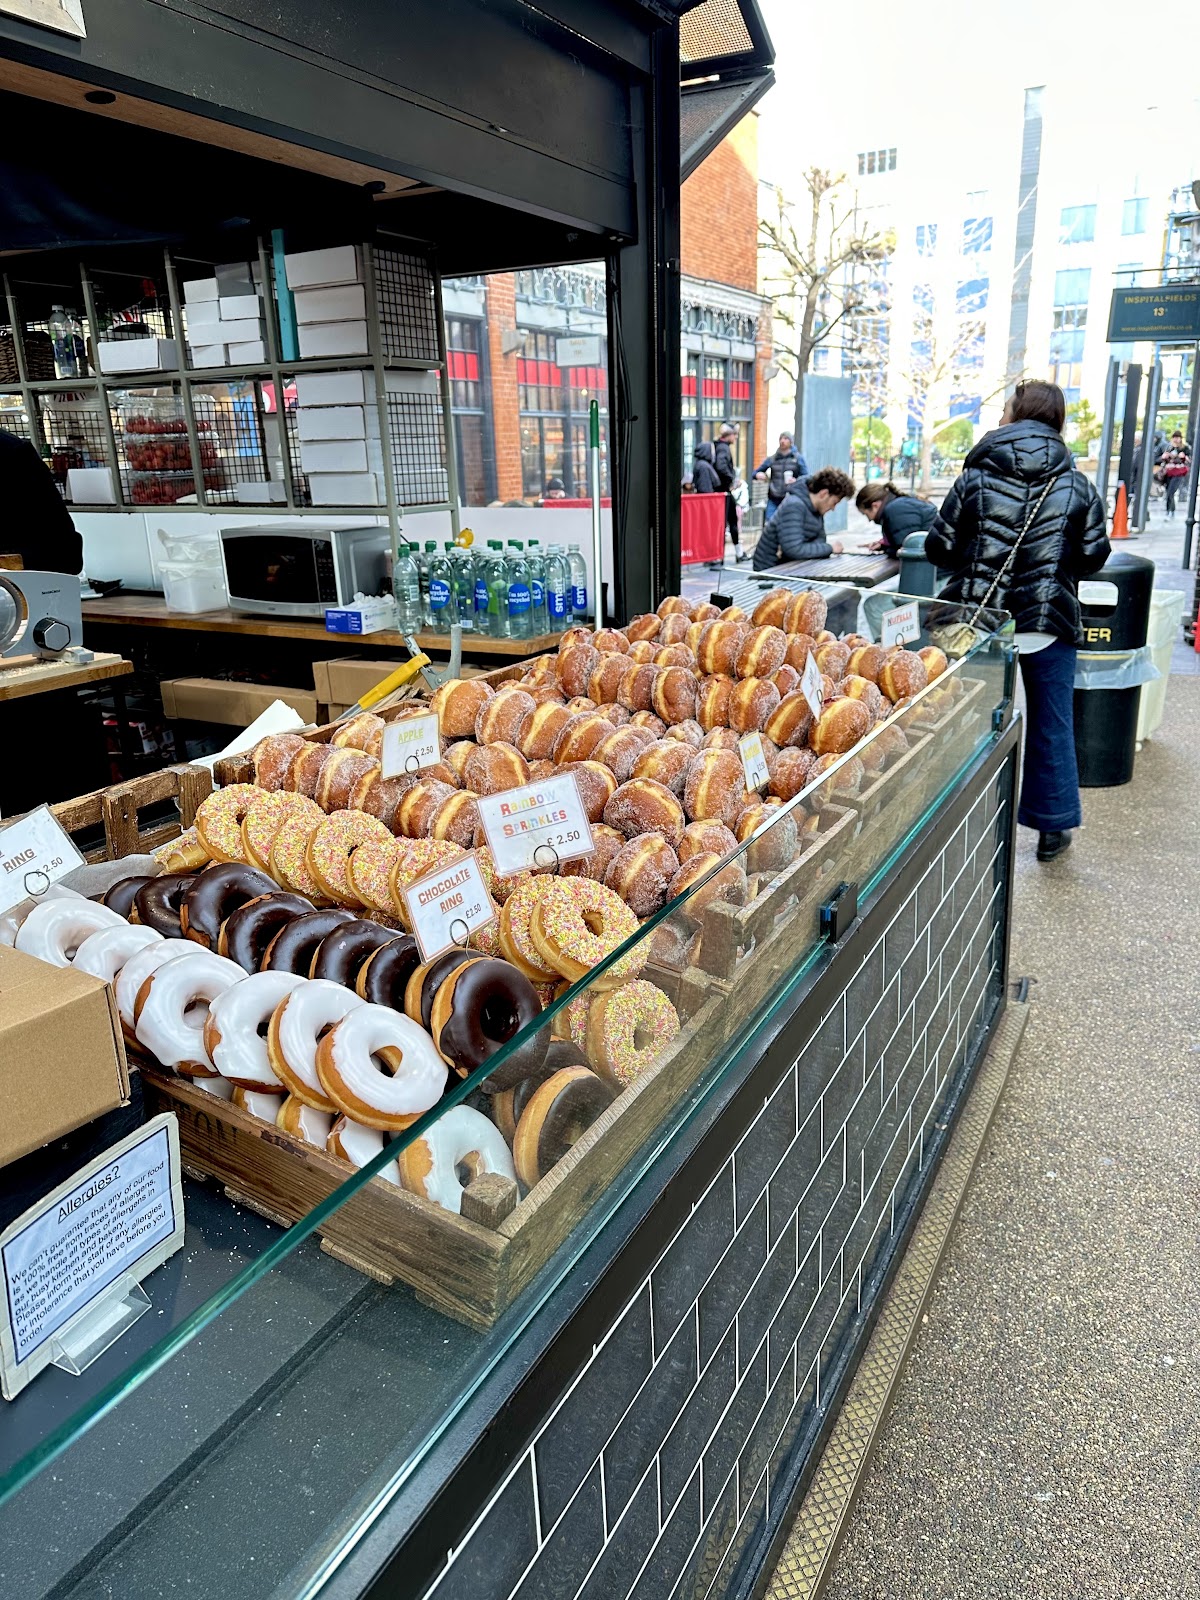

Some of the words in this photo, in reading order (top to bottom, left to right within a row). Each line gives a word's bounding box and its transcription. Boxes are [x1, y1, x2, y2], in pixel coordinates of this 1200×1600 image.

[555, 577, 564, 613] smart
[576, 571, 585, 605] smart
[398, 729, 424, 744] APPLE
[557, 830, 580, 846] 2.50
[2, 848, 35, 872] RING
[418, 869, 471, 904] CHOCOLATE
[440, 892, 463, 912] RING
[465, 903, 482, 919] £2.50
[58, 1165, 120, 1224] Allergies?
[11, 1269, 27, 1284] We
[28, 1249, 48, 1270] can't
[50, 1216, 89, 1253] guarantee
[91, 1203, 106, 1218] that
[108, 1192, 122, 1207] any
[124, 1184, 132, 1195] of
[133, 1174, 147, 1187] our
[148, 1161, 164, 1178] food
[13, 1285, 21, 1296] is
[24, 1264, 45, 1285] 100%
[48, 1249, 64, 1266] free
[65, 1232, 83, 1250] from
[84, 1212, 109, 1234] traces
[110, 1203, 117, 1214] of
[14, 1294, 25, 1306] as
[26, 1282, 38, 1296] we
[40, 1257, 68, 1282] handle
[69, 1245, 78, 1258] all
[79, 1229, 101, 1249] types
[103, 1219, 111, 1230] of
[112, 1194, 147, 1221] allergens
[148, 1188, 155, 1196] in
[16, 1297, 46, 1326] Please
[47, 1273, 72, 1299] inform
[72, 1261, 86, 1276] our
[87, 1244, 105, 1264] staff
[106, 1237, 114, 1249] of
[115, 1227, 130, 1242] any
[131, 1202, 163, 1230] allergies
[15, 1302, 30, 1316] our
[31, 1283, 50, 1304] busy
[52, 1256, 80, 1283] kitchen
[81, 1241, 97, 1258] and
[98, 1220, 127, 1244] bakery.
[18, 1323, 28, 1336] or
[29, 1286, 73, 1324] intolerance
[74, 1269, 90, 1287] that
[90, 1257, 105, 1275] you
[107, 1242, 126, 1260] have
[126, 1222, 152, 1243] before
[152, 1210, 166, 1228] you
[20, 1323, 44, 1347] order
